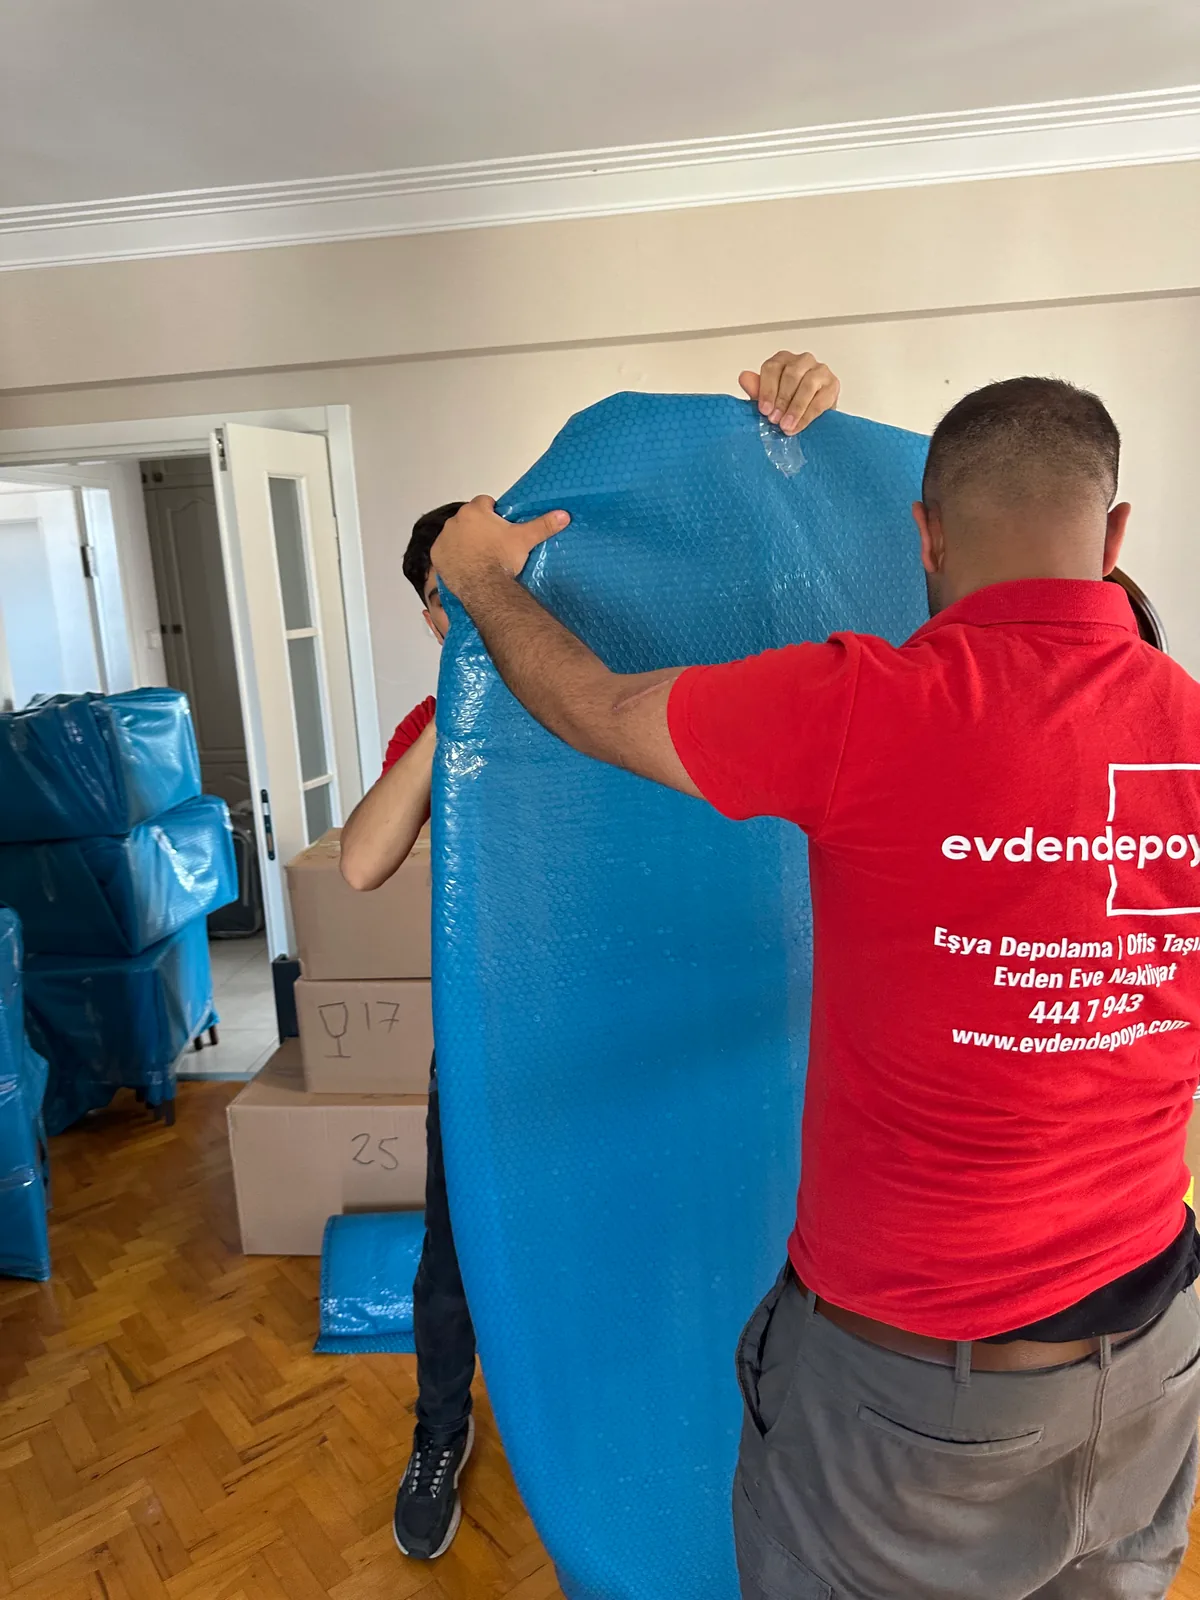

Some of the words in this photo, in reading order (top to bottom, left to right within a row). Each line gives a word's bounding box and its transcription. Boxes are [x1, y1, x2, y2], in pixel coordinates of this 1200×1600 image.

[934, 926, 992, 955] Eşya
[1000, 936, 1113, 961] Depolama
[1127, 933, 1156, 956] Ofis
[1162, 933, 1200, 956] Taşı
[994, 966, 1063, 989] Evden
[1069, 968, 1104, 988] Eve
[1107, 963, 1178, 987] Nakliyat
[364, 1000, 400, 1034] 17
[1028, 1001, 1080, 1024] 444
[1086, 999, 1100, 1022] 7
[1102, 993, 1144, 1019] 943
[952, 1019, 1190, 1053] www.evdendepoya.com
[351, 1132, 399, 1171] 25
